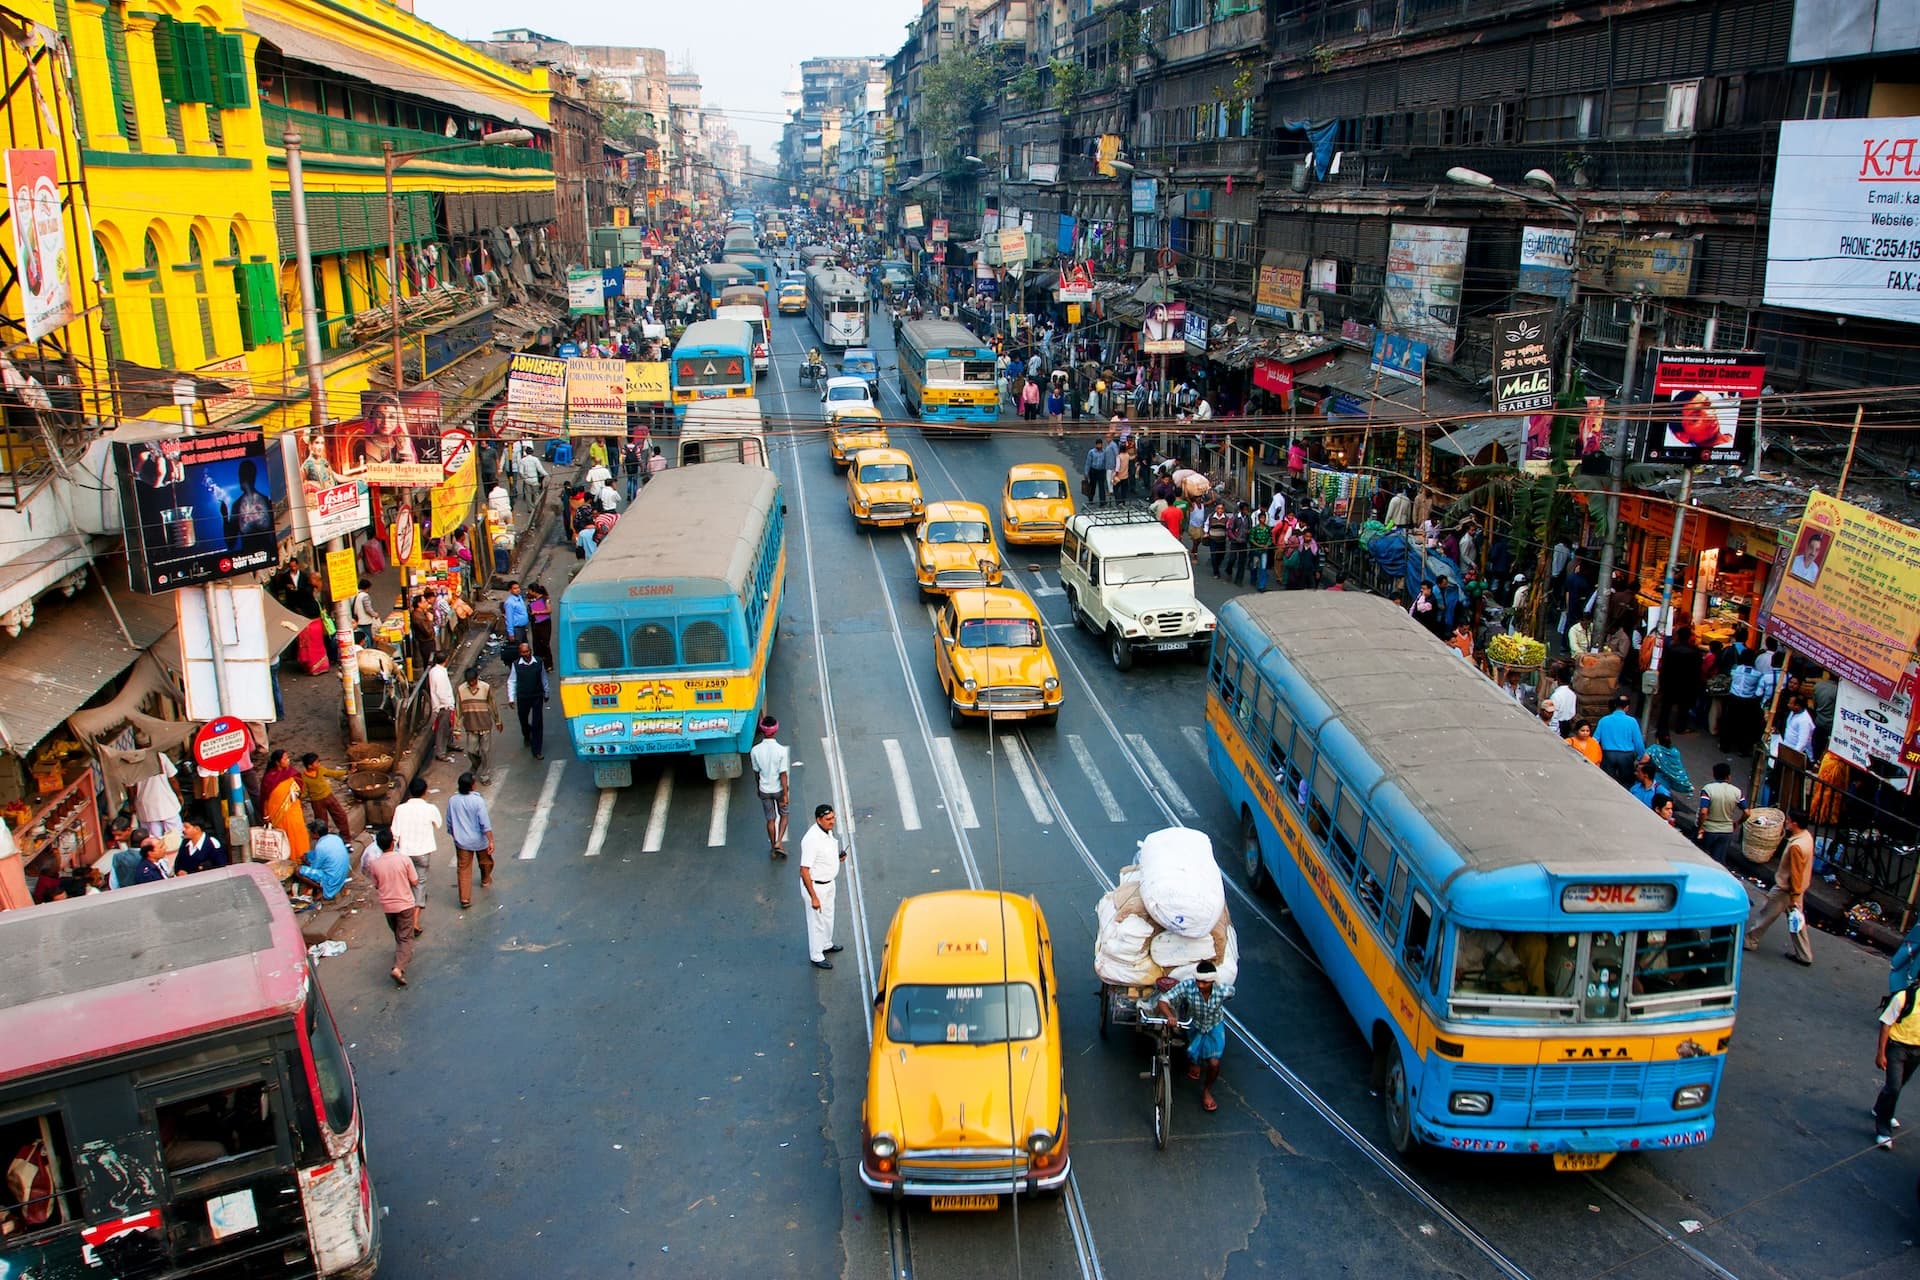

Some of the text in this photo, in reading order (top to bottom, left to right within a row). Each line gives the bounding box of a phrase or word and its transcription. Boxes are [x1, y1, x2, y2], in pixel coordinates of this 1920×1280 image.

[1859, 138, 1920, 176] KA
[511, 355, 567, 378] ABHISHEK
[569, 360, 624, 372] ROYAL TOUCH
[1661, 367, 1682, 376] Died
[1698, 368, 1717, 378] Oral
[1501, 372, 1549, 400] Mala
[1501, 397, 1549, 412] SAREES
[592, 683, 618, 695] STOP
[946, 943, 979, 952] TAXI
[946, 986, 983, 1000] JAI MATA DI
[1565, 1047, 1628, 1058] TATA
[1451, 1137, 1507, 1151] SPEED
